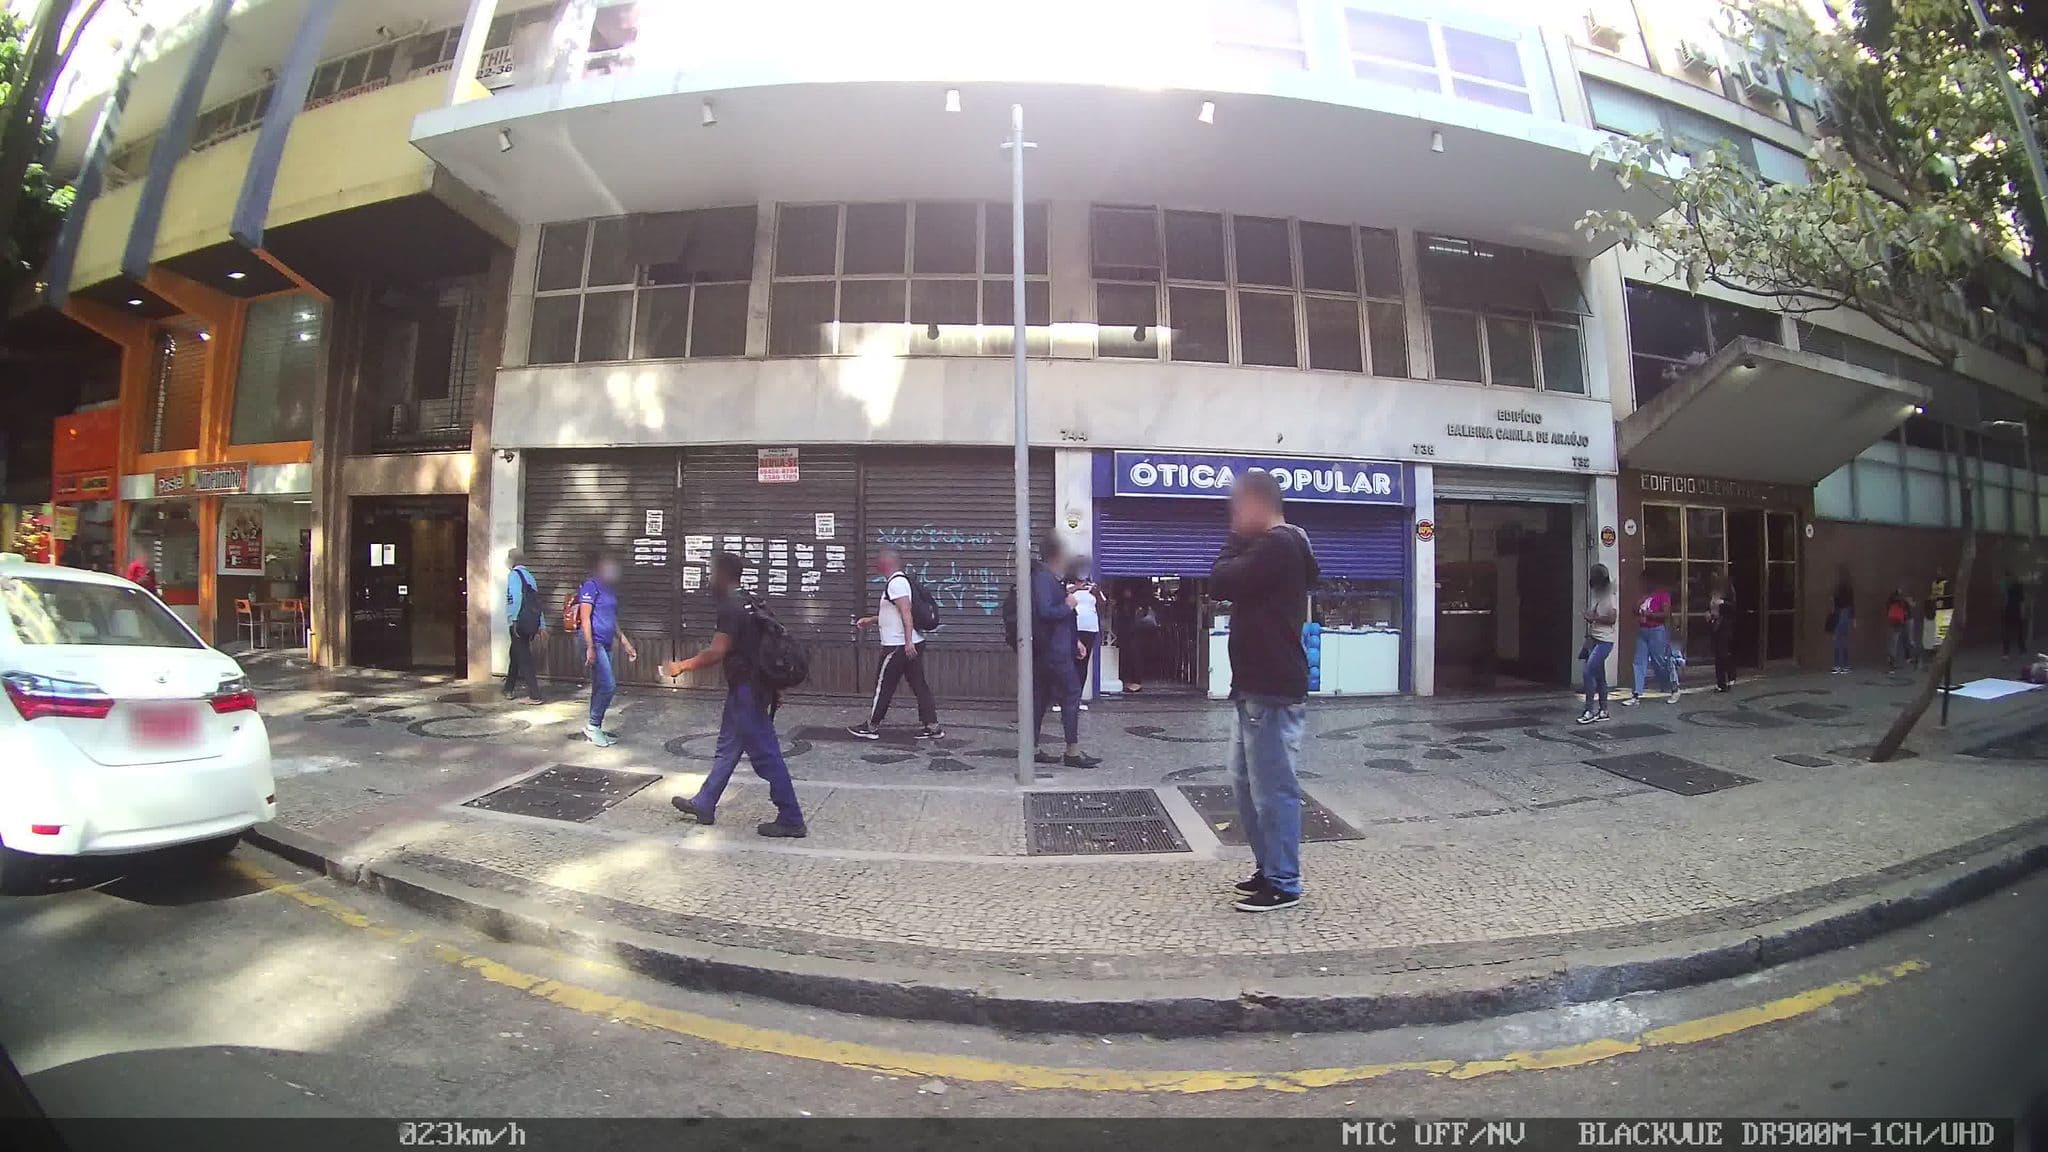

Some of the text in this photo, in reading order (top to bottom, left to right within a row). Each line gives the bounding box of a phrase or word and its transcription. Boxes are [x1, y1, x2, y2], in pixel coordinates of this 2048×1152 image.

[1497, 409, 1542, 424] EDIFÍCIO
[1060, 430, 1088, 441] 744
[1447, 424, 1589, 448] BALBINA CAMILA DE ARAÚJO
[1129, 458, 1235, 488] ÓTICA
[1641, 473, 1696, 493] EDIFICIO
